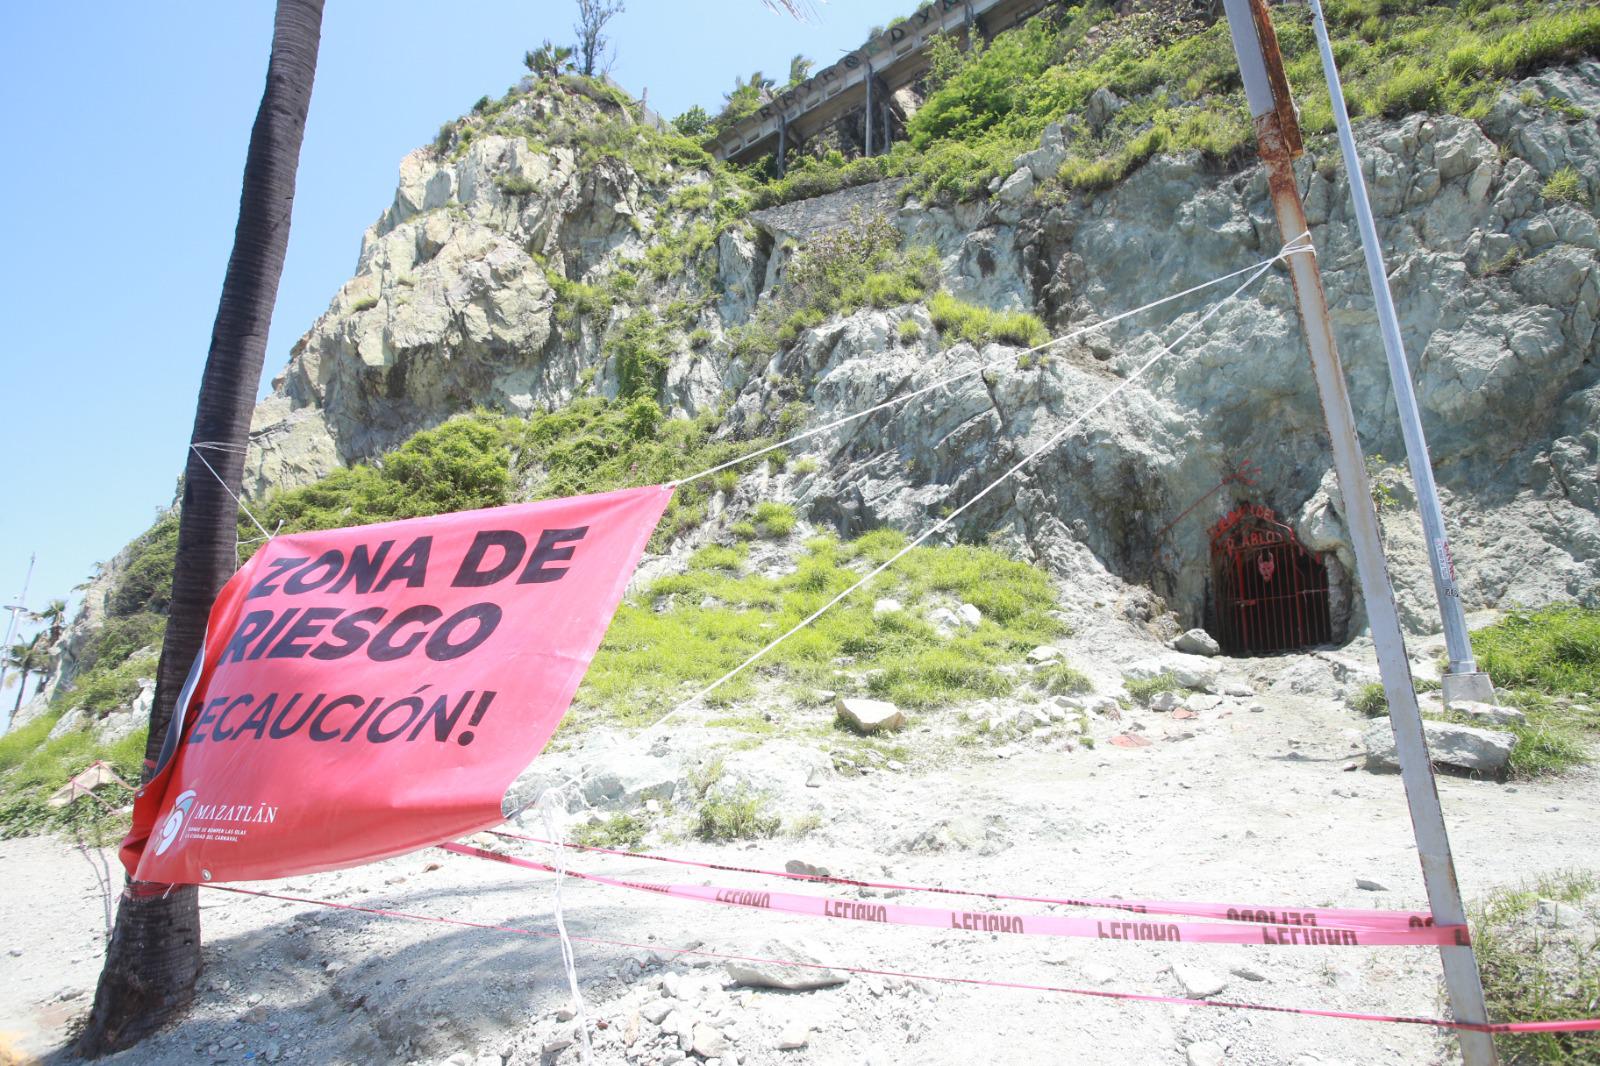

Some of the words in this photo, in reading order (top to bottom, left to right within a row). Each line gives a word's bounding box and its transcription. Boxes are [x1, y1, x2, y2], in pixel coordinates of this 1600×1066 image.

[247, 535, 433, 600] ZONA
[450, 525, 590, 588] DE
[219, 602, 503, 664] RIESGO
